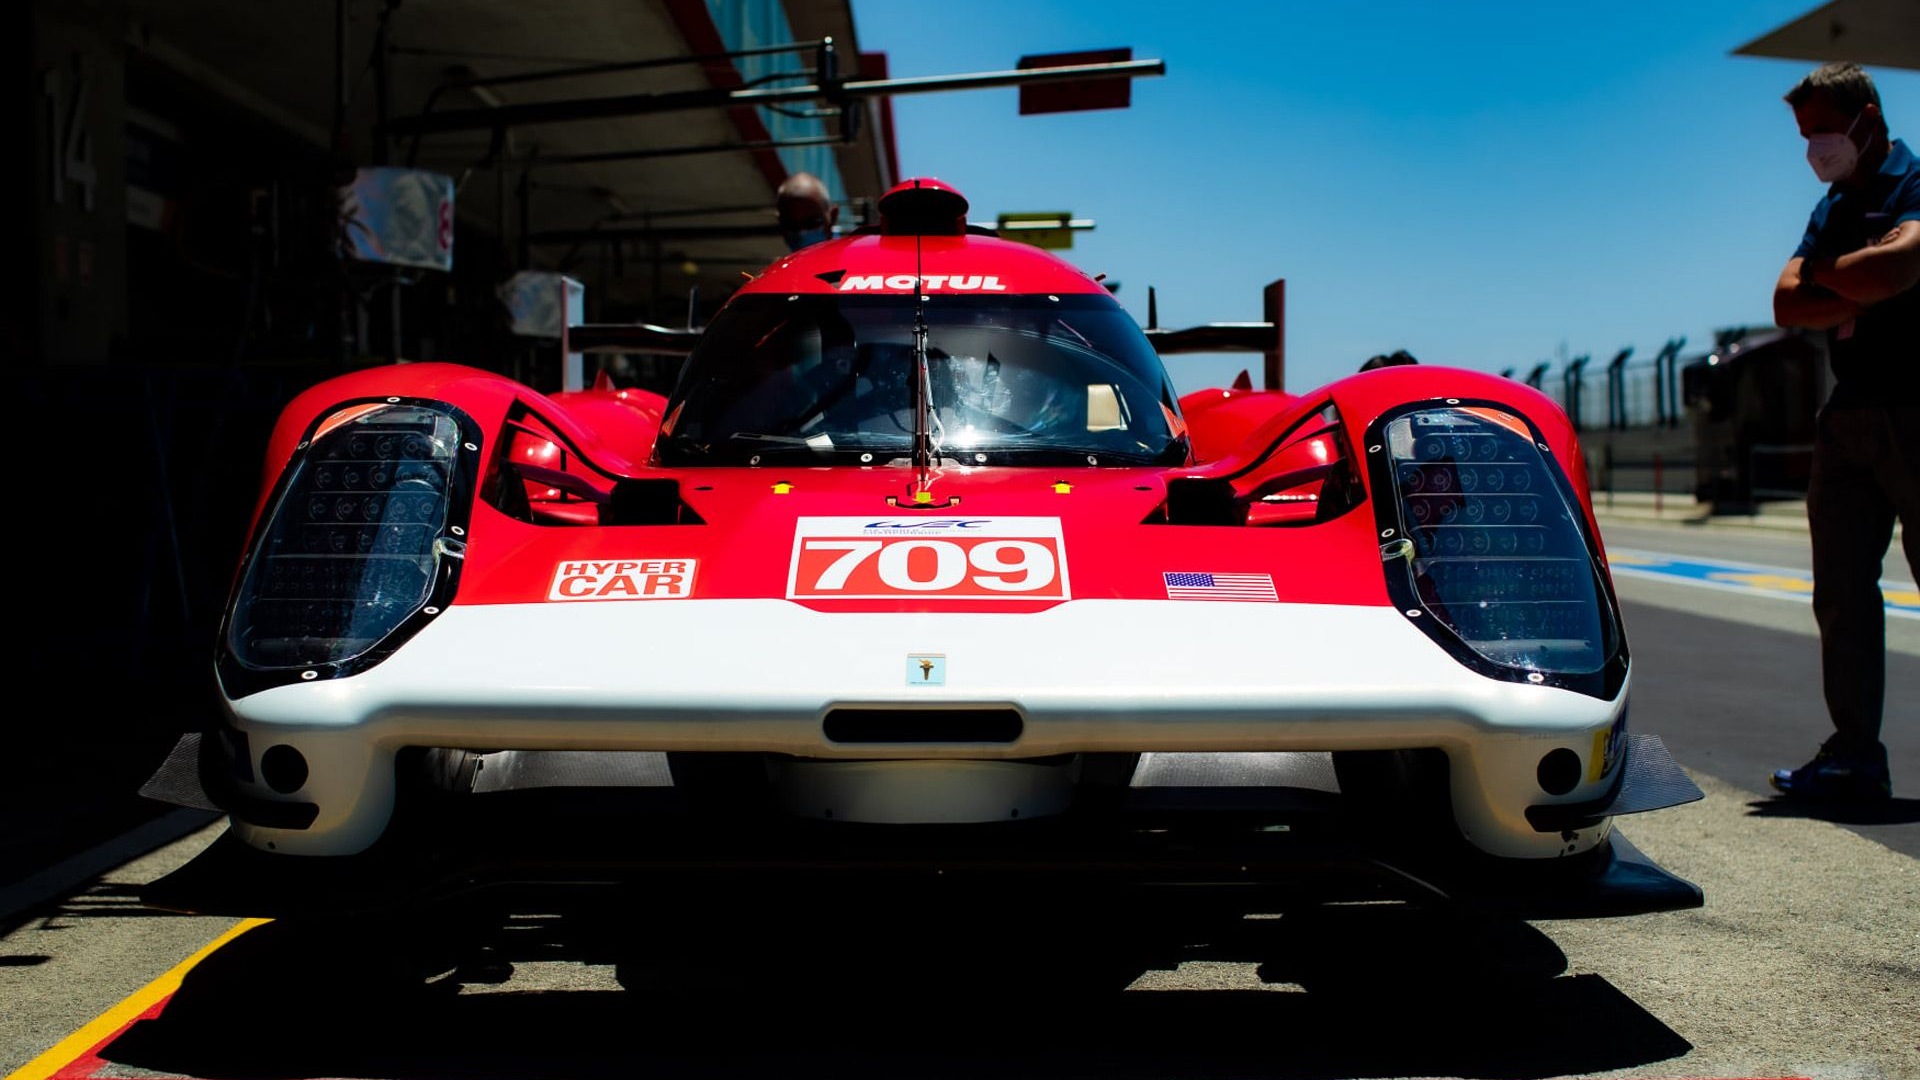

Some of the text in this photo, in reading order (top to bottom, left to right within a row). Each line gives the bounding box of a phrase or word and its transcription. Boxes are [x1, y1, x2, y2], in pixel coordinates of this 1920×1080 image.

[43, 68, 96, 213] 14
[839, 274, 1007, 291] MOTUL
[863, 519, 993, 530] WEC
[564, 561, 687, 576] HYPER
[804, 539, 1056, 592] 709
[558, 573, 684, 597] CAR
